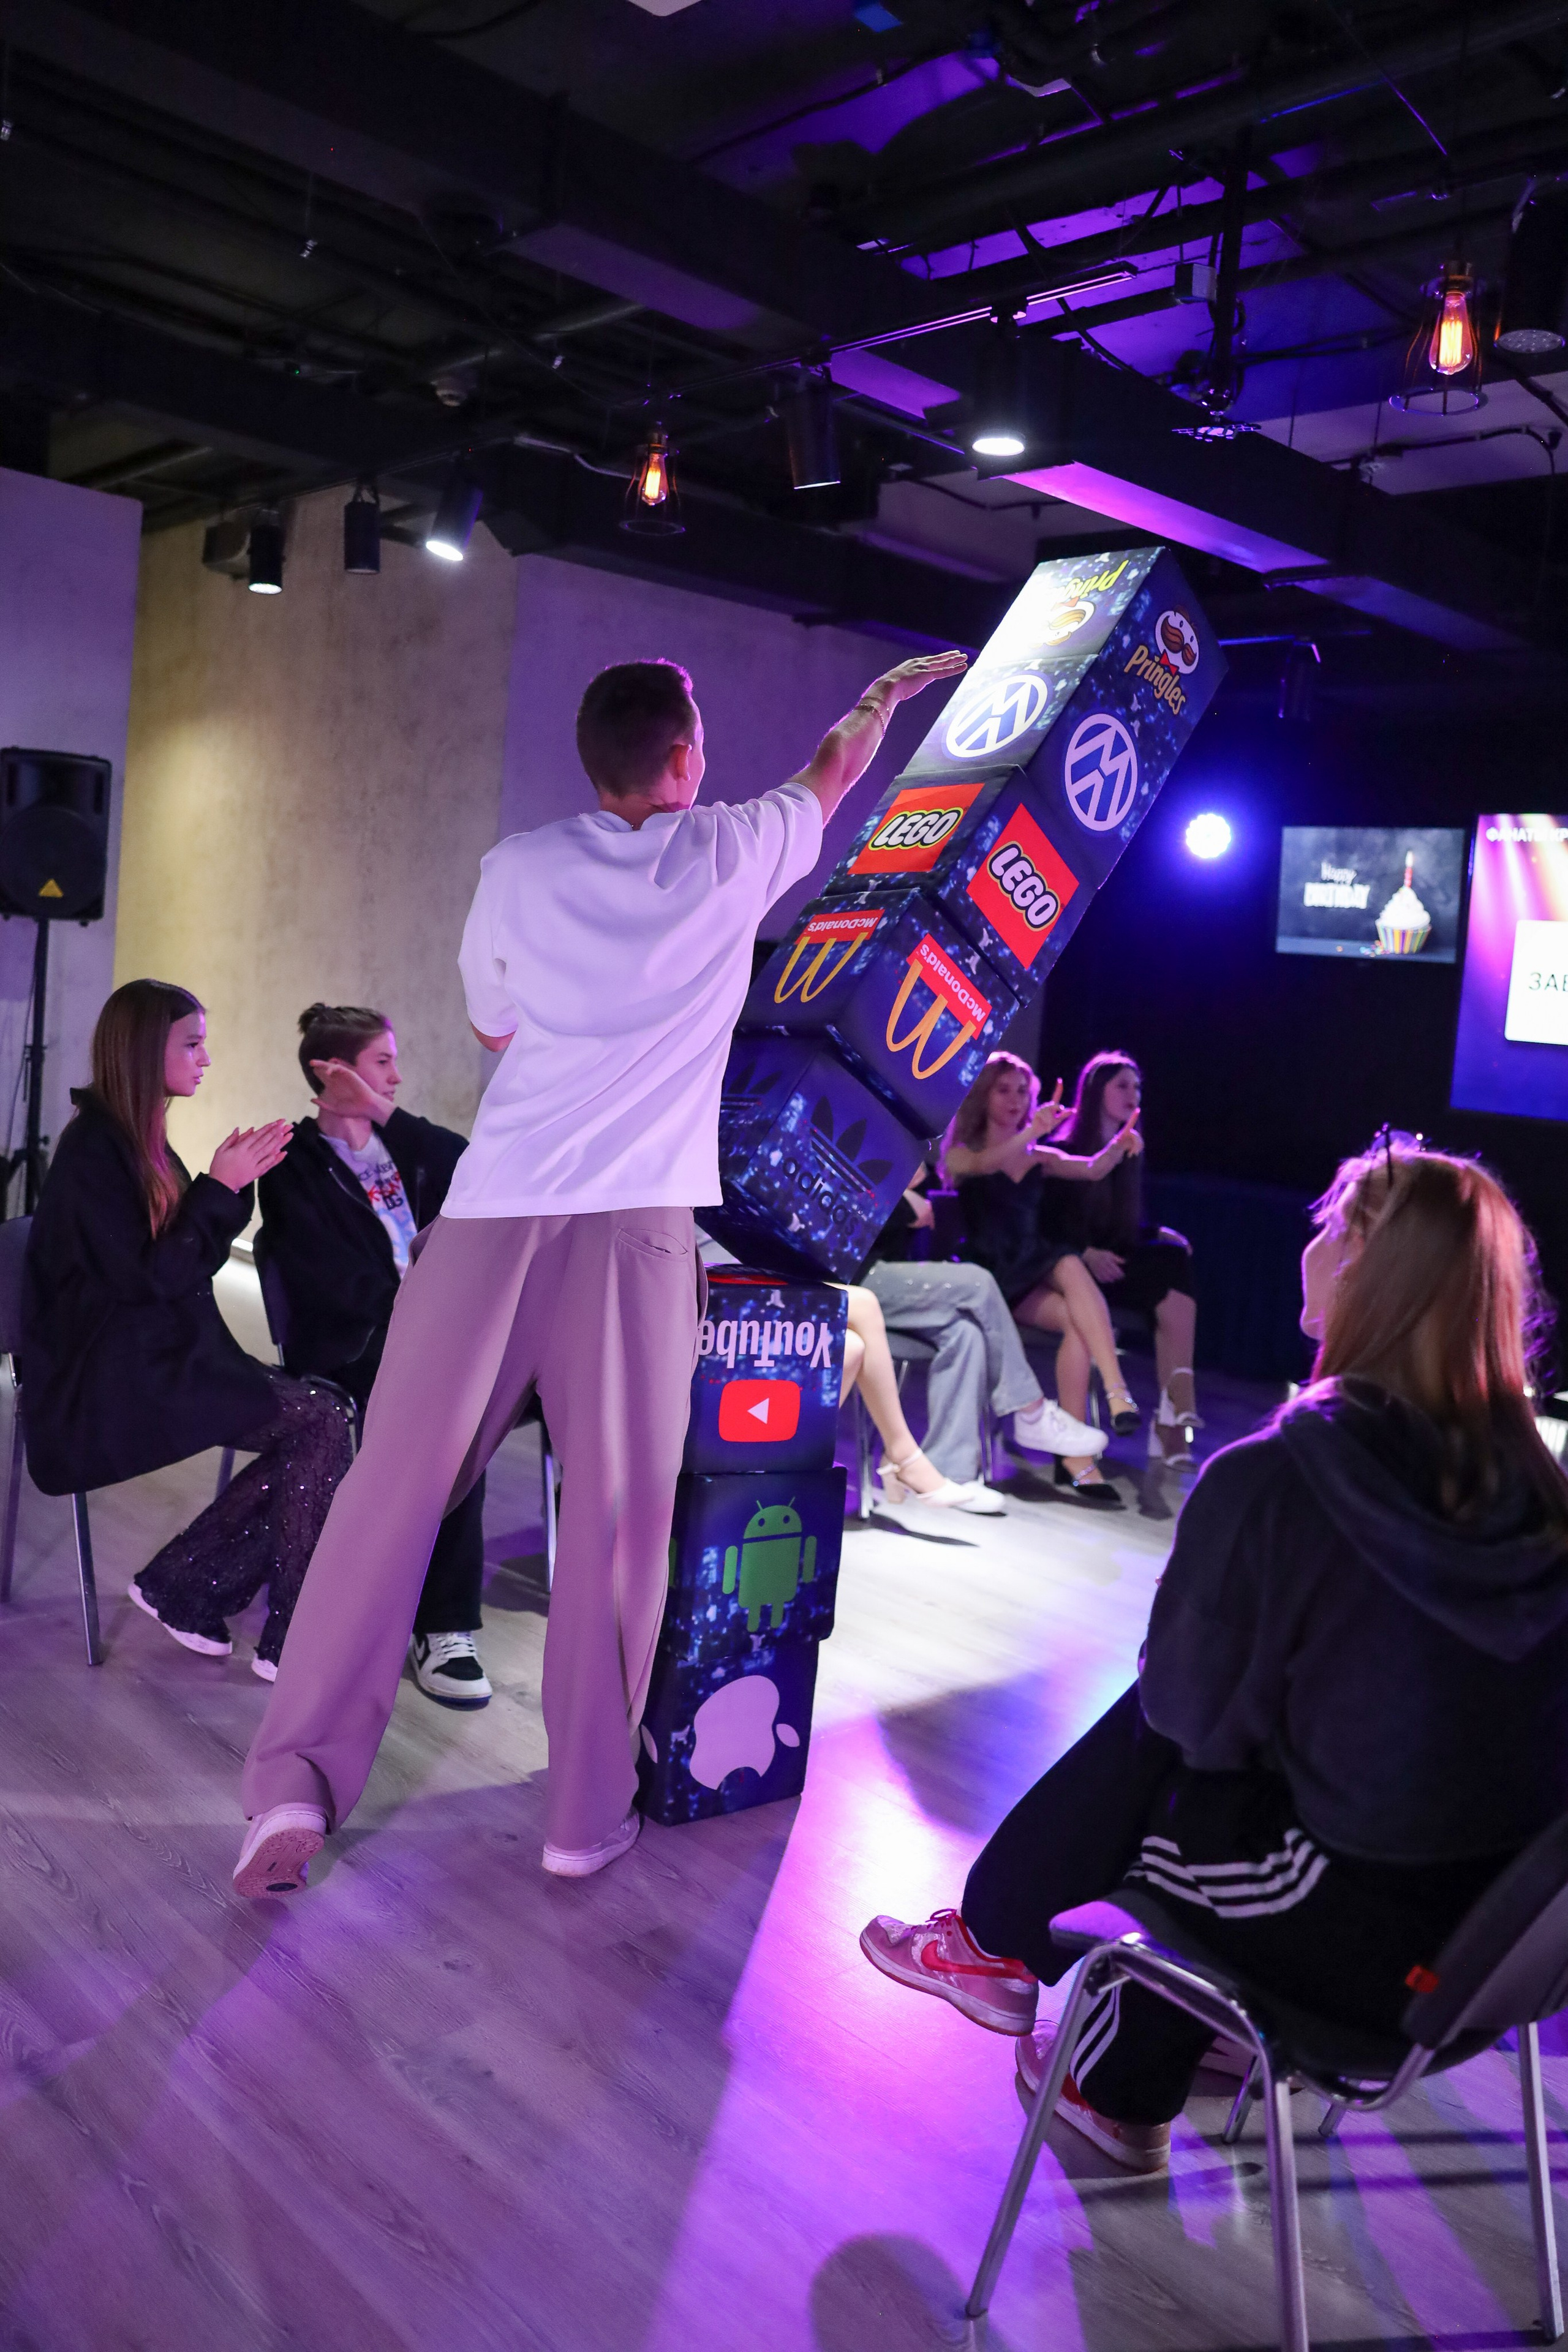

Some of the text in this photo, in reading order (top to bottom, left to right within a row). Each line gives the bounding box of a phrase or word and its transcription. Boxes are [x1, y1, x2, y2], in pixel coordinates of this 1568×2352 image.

[1123, 645, 1187, 715] Pringles
[872, 810, 960, 849] LEGO
[990, 845, 1059, 928] LEGO
[807, 917, 878, 932] McDonald's
[920, 944, 986, 1022] McDonald's
[782, 1157, 860, 1236] adidas
[698, 1320, 832, 1369] YouTube
